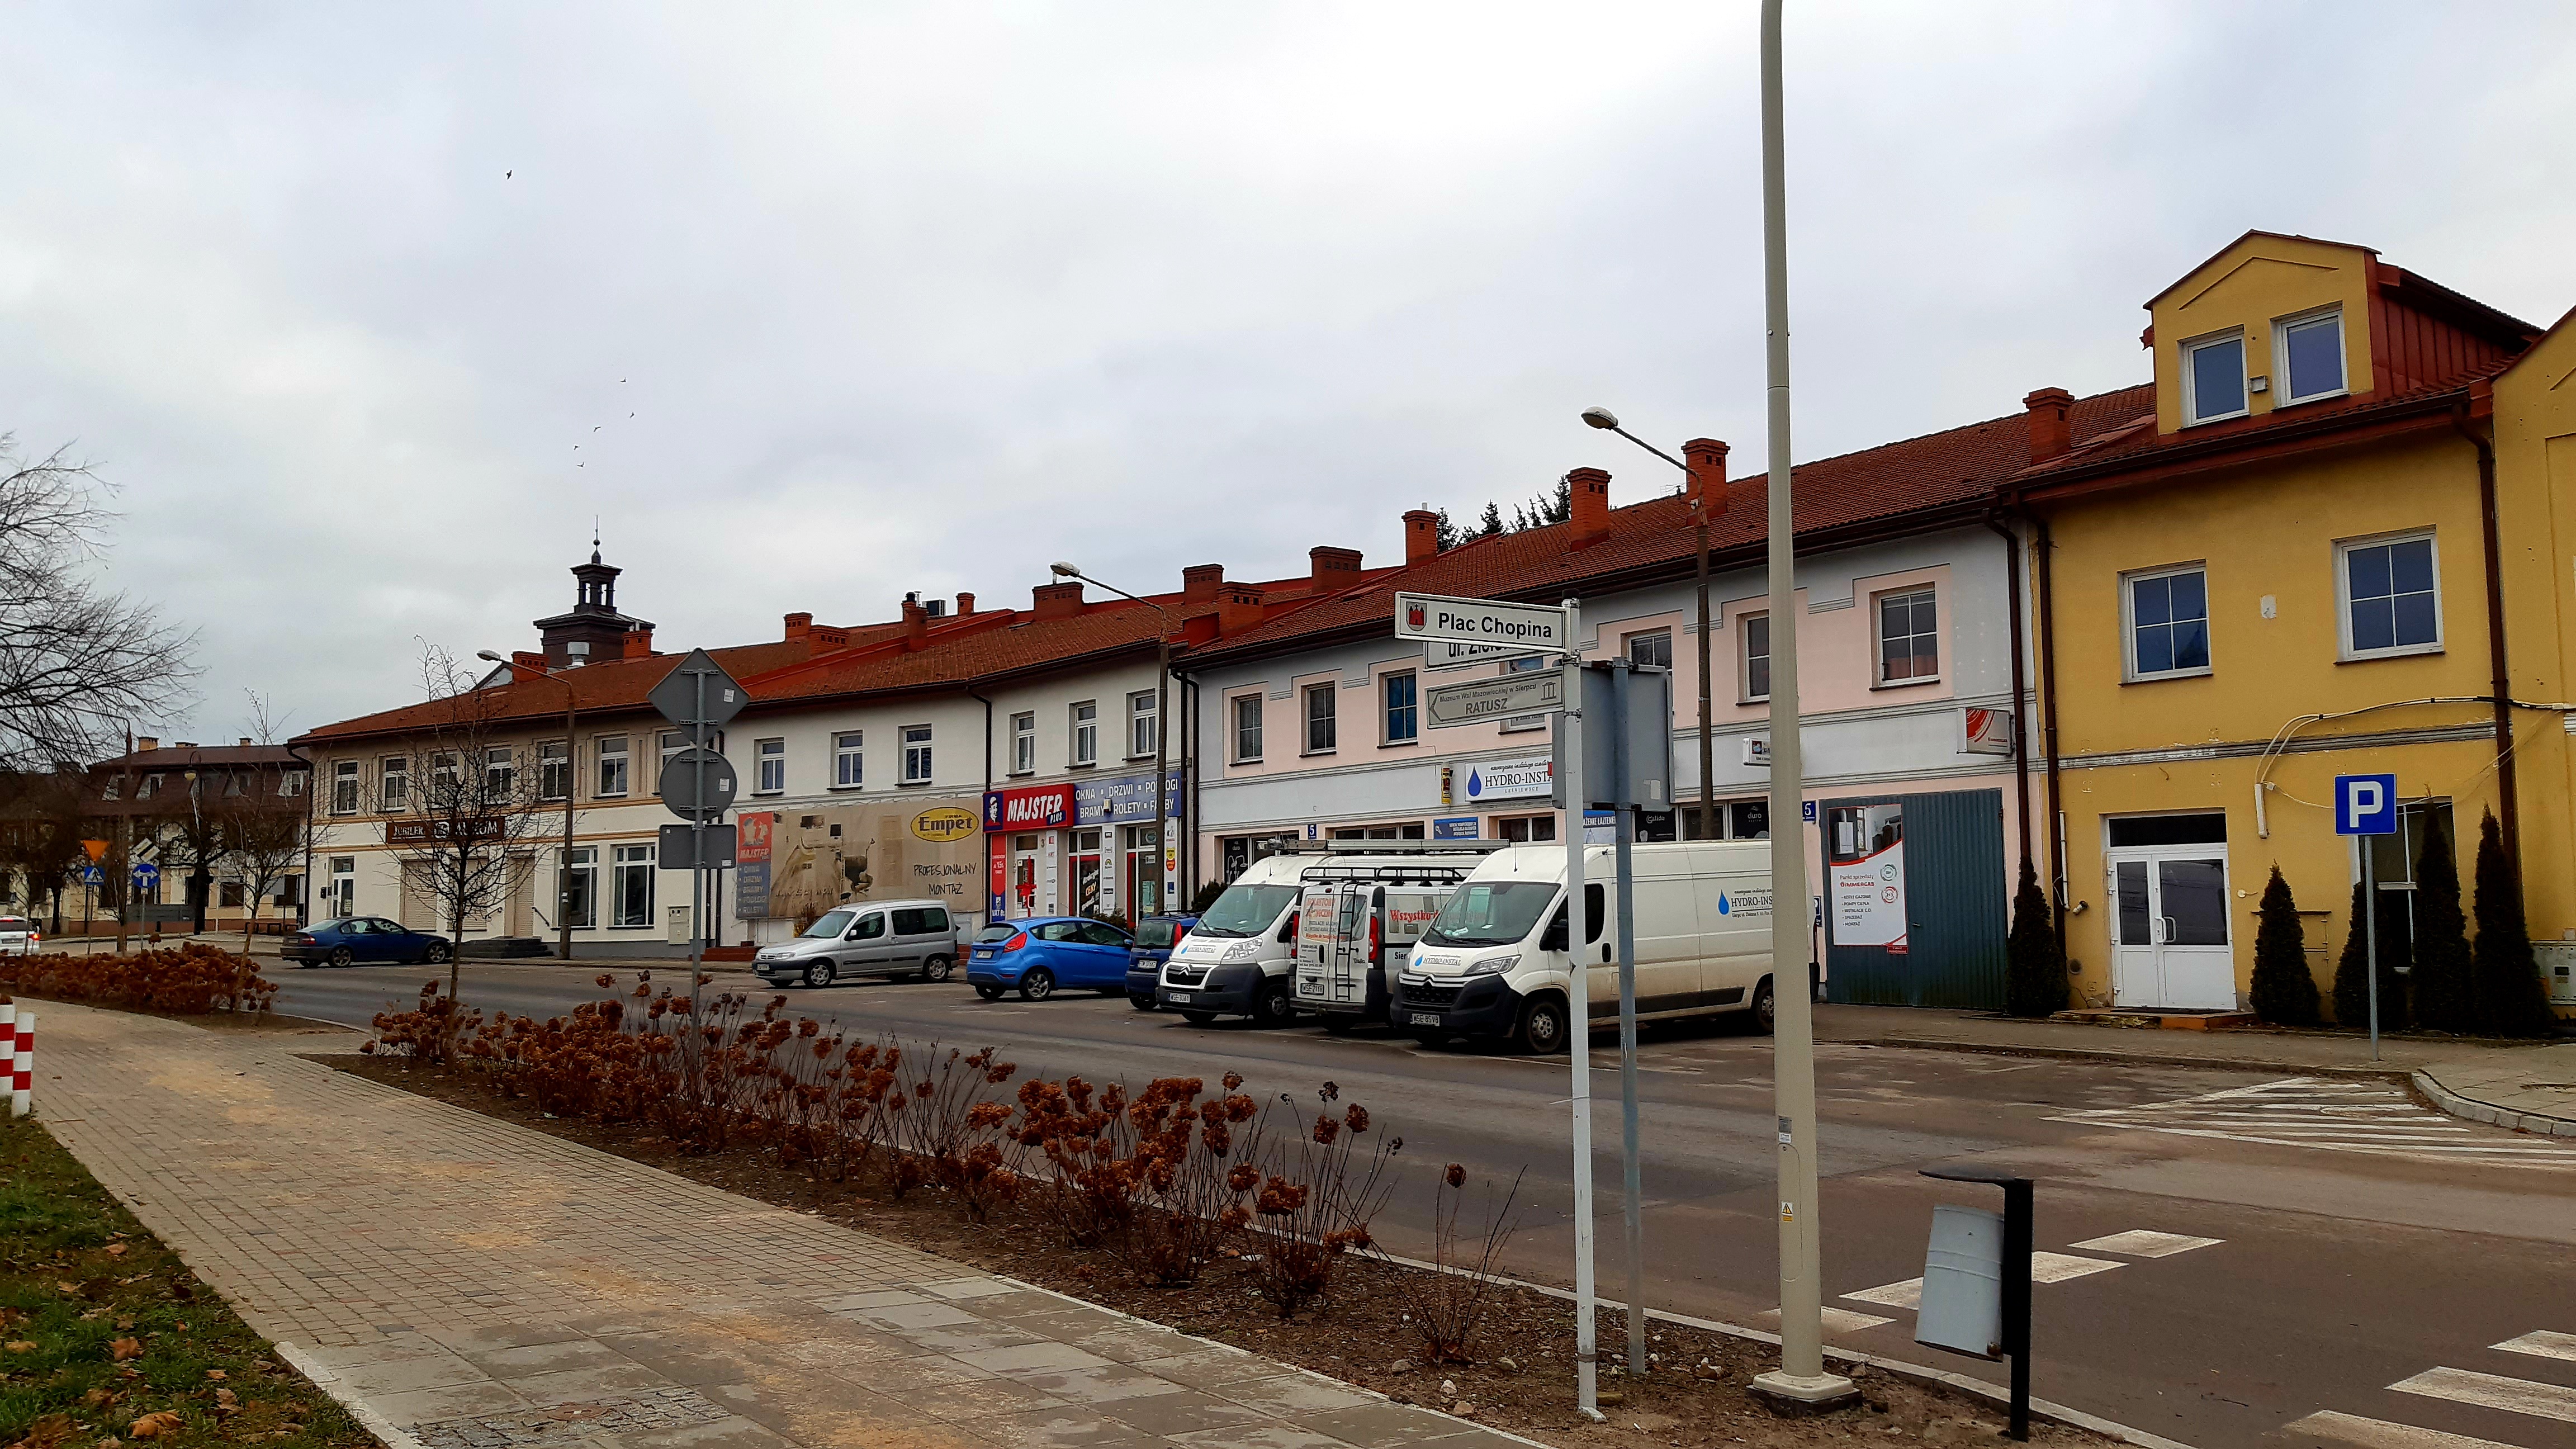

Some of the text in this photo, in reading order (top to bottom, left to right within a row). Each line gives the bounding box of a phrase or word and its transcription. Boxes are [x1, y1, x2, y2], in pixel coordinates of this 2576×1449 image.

[1438, 612, 1552, 640] Plac Chopina
[1439, 694, 1460, 703] Muzeum
[1472, 687, 1508, 698] Mazowieckiej
[1515, 684, 1536, 692] Sierpcu
[1465, 698, 1508, 714] RATUSZ
[1076, 778, 1178, 801] OKNA DRZWI POOGI
[1007, 794, 1063, 822] MAJSTER
[1079, 798, 1174, 818] BRAMY ROLETY FBY
[1805, 803, 1811, 816] 5
[2348, 781, 2383, 828] P
[1050, 812, 1062, 824] PLUS
[918, 816, 973, 836] Empet
[1309, 825, 1314, 835] 5
[1041, 839, 1045, 848] 3
[740, 848, 769, 859] MAJSTER
[913, 863, 977, 877] PROFESJONALNY
[928, 882, 963, 895] MONTAŻ
[1390, 910, 1432, 922] Wszystko
